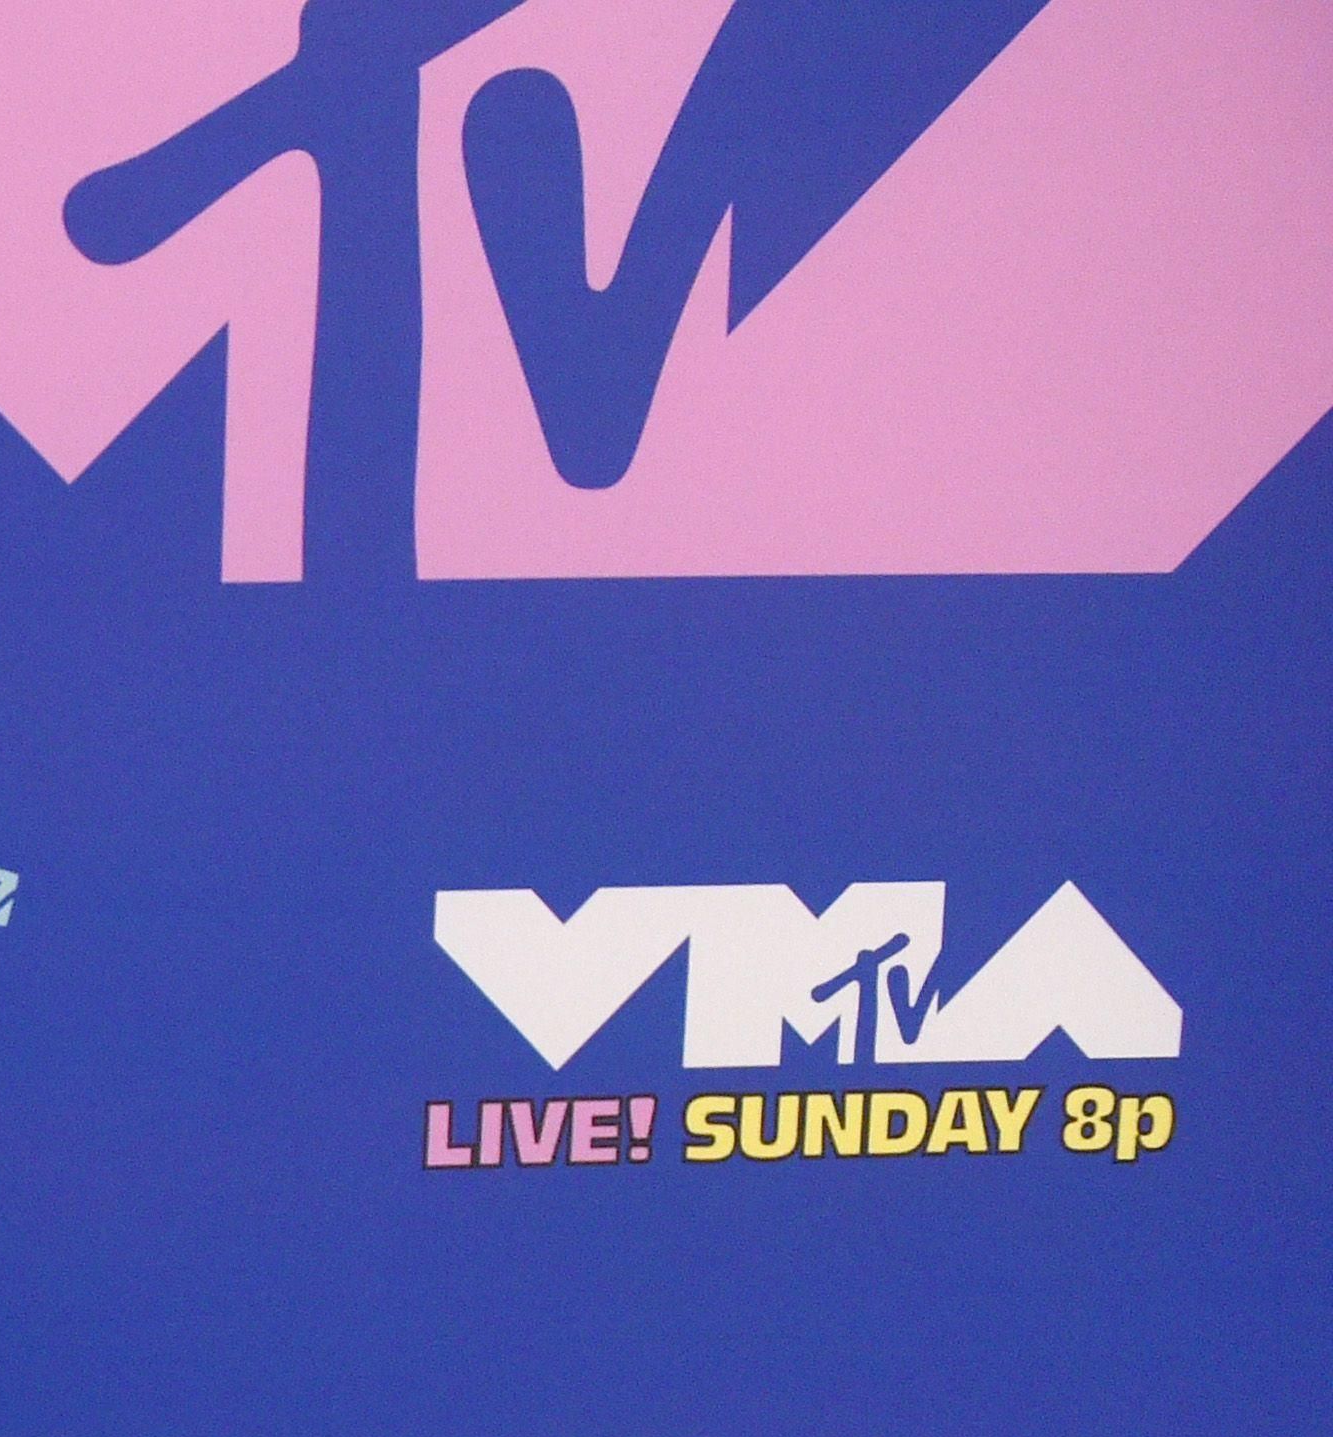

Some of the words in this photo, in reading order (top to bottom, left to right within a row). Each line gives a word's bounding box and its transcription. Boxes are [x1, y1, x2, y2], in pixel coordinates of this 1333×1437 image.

[433, 880, 1183, 1071] VMA
[424, 1095, 657, 1169] LIVE!
[683, 1087, 1042, 1163] SUNDAY
[1061, 1084, 1176, 1162] 8p
